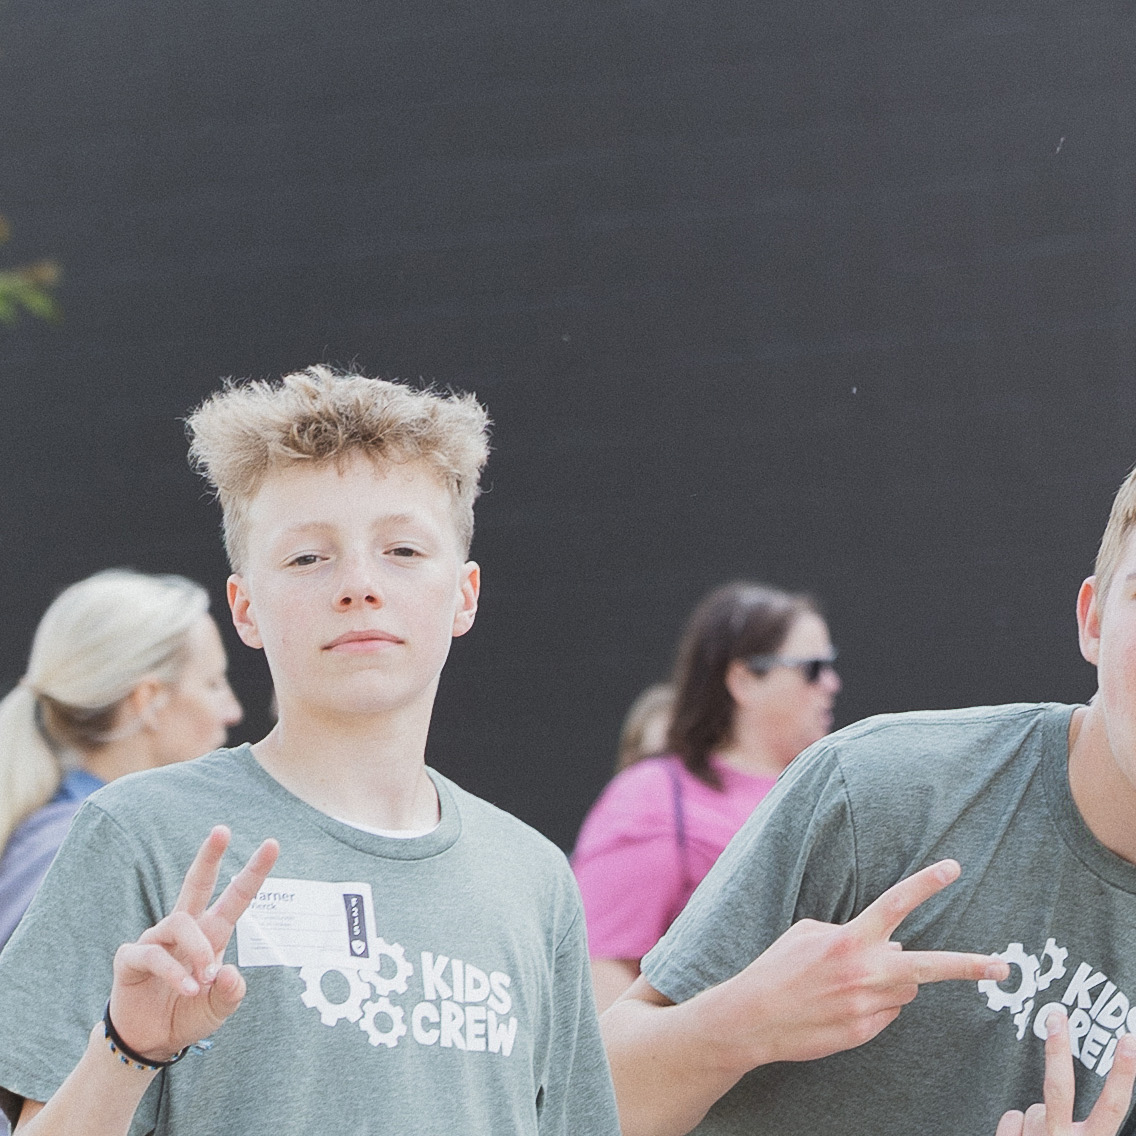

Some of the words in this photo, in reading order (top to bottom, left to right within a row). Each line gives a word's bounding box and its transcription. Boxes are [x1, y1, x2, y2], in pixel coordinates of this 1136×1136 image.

[252, 891, 296, 902] arner
[420, 951, 513, 1015] KIDS
[411, 1001, 518, 1057] CREW
